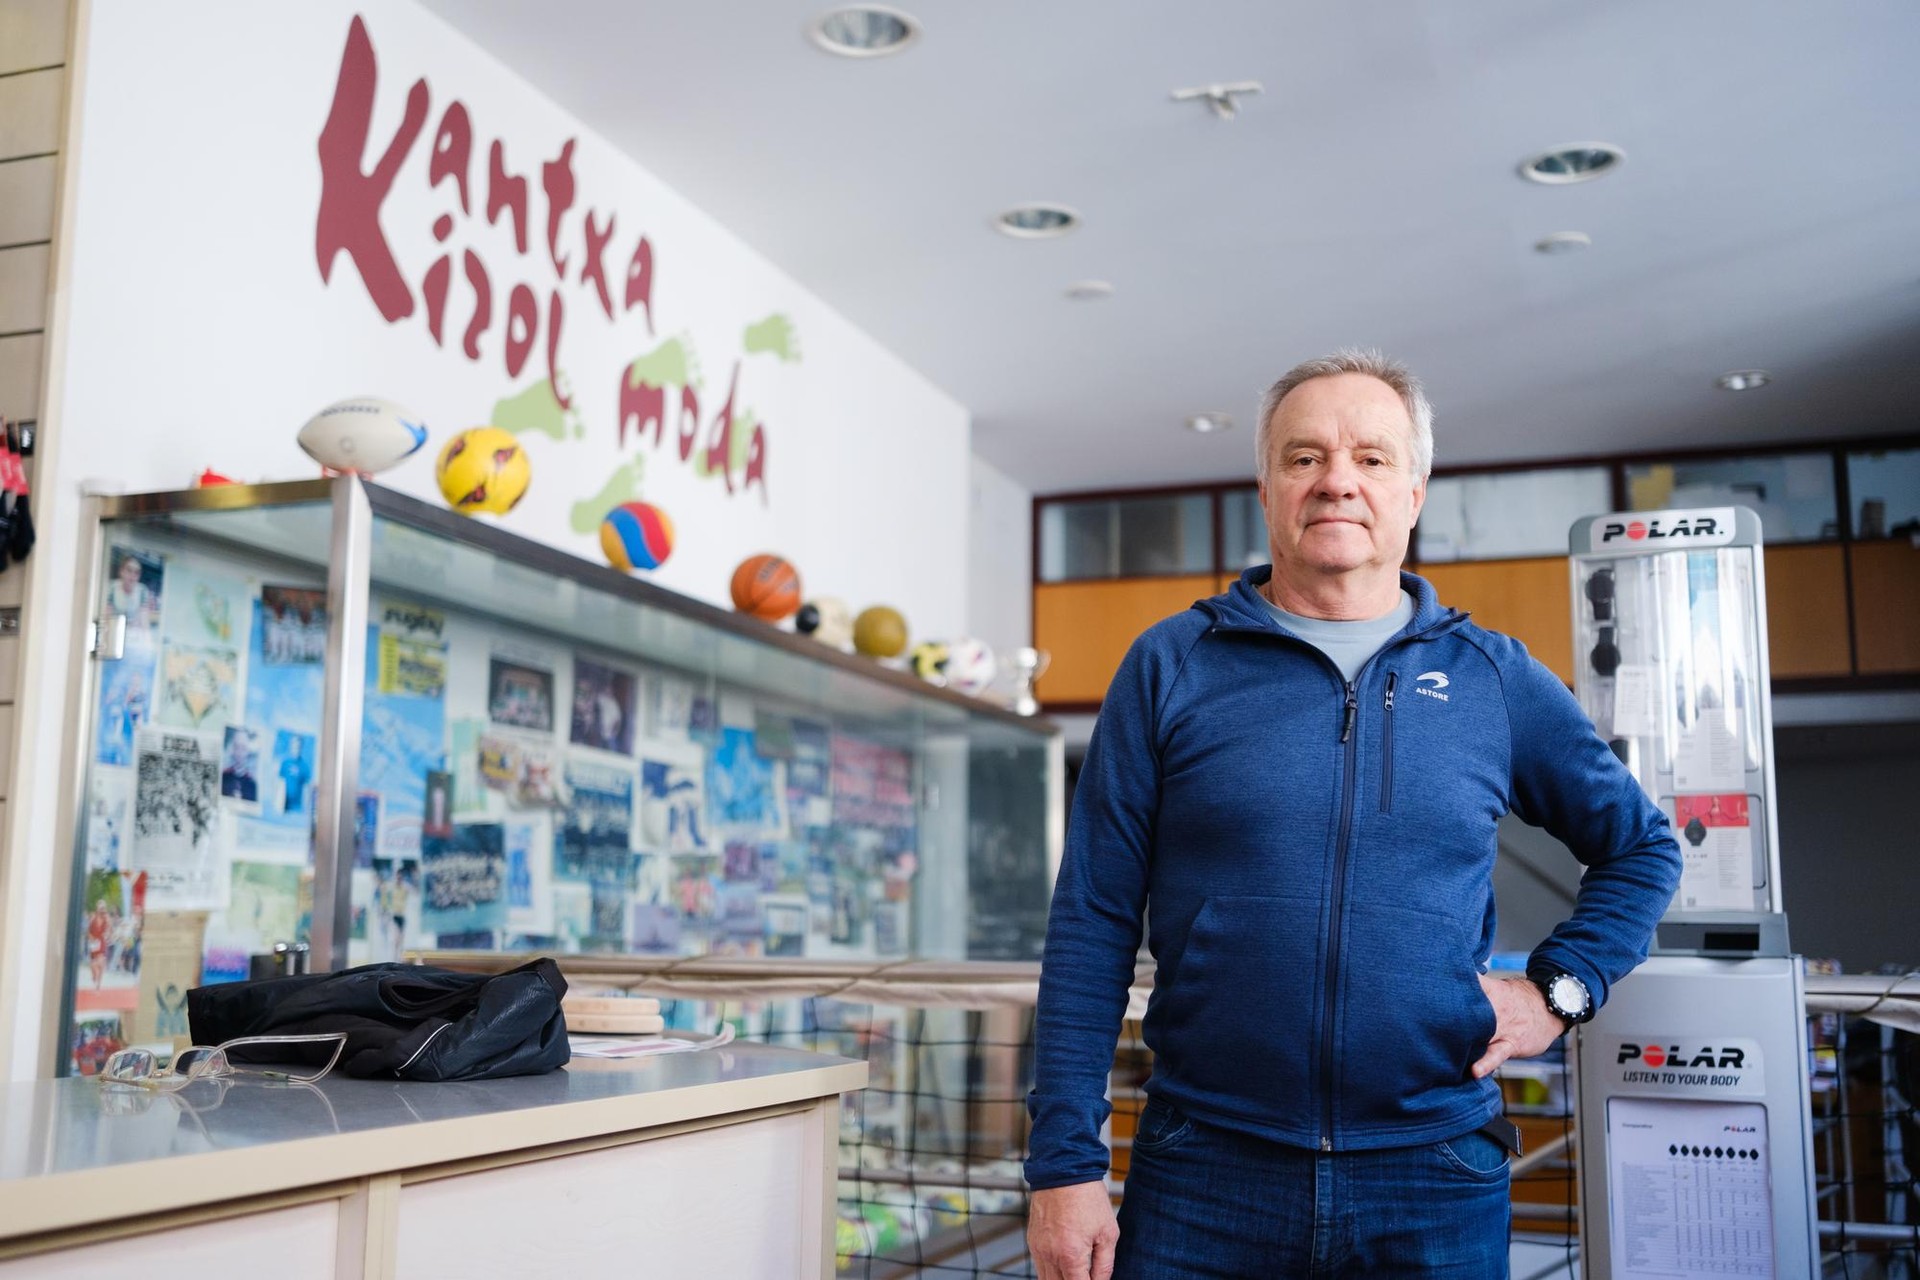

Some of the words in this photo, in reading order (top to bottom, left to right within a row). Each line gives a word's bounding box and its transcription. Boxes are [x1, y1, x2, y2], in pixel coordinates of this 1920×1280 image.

[620, 360, 769, 509] moda
[1415, 687, 1449, 702] ASTORE
[1616, 1043, 1745, 1069] POLAR
[1623, 1071, 1659, 1084] LISTEN
[1662, 1073, 1676, 1085] TO
[1678, 1073, 1708, 1086] YOUR
[1710, 1074, 1741, 1087] BODY
[1723, 1125, 1757, 1133] POLAR
